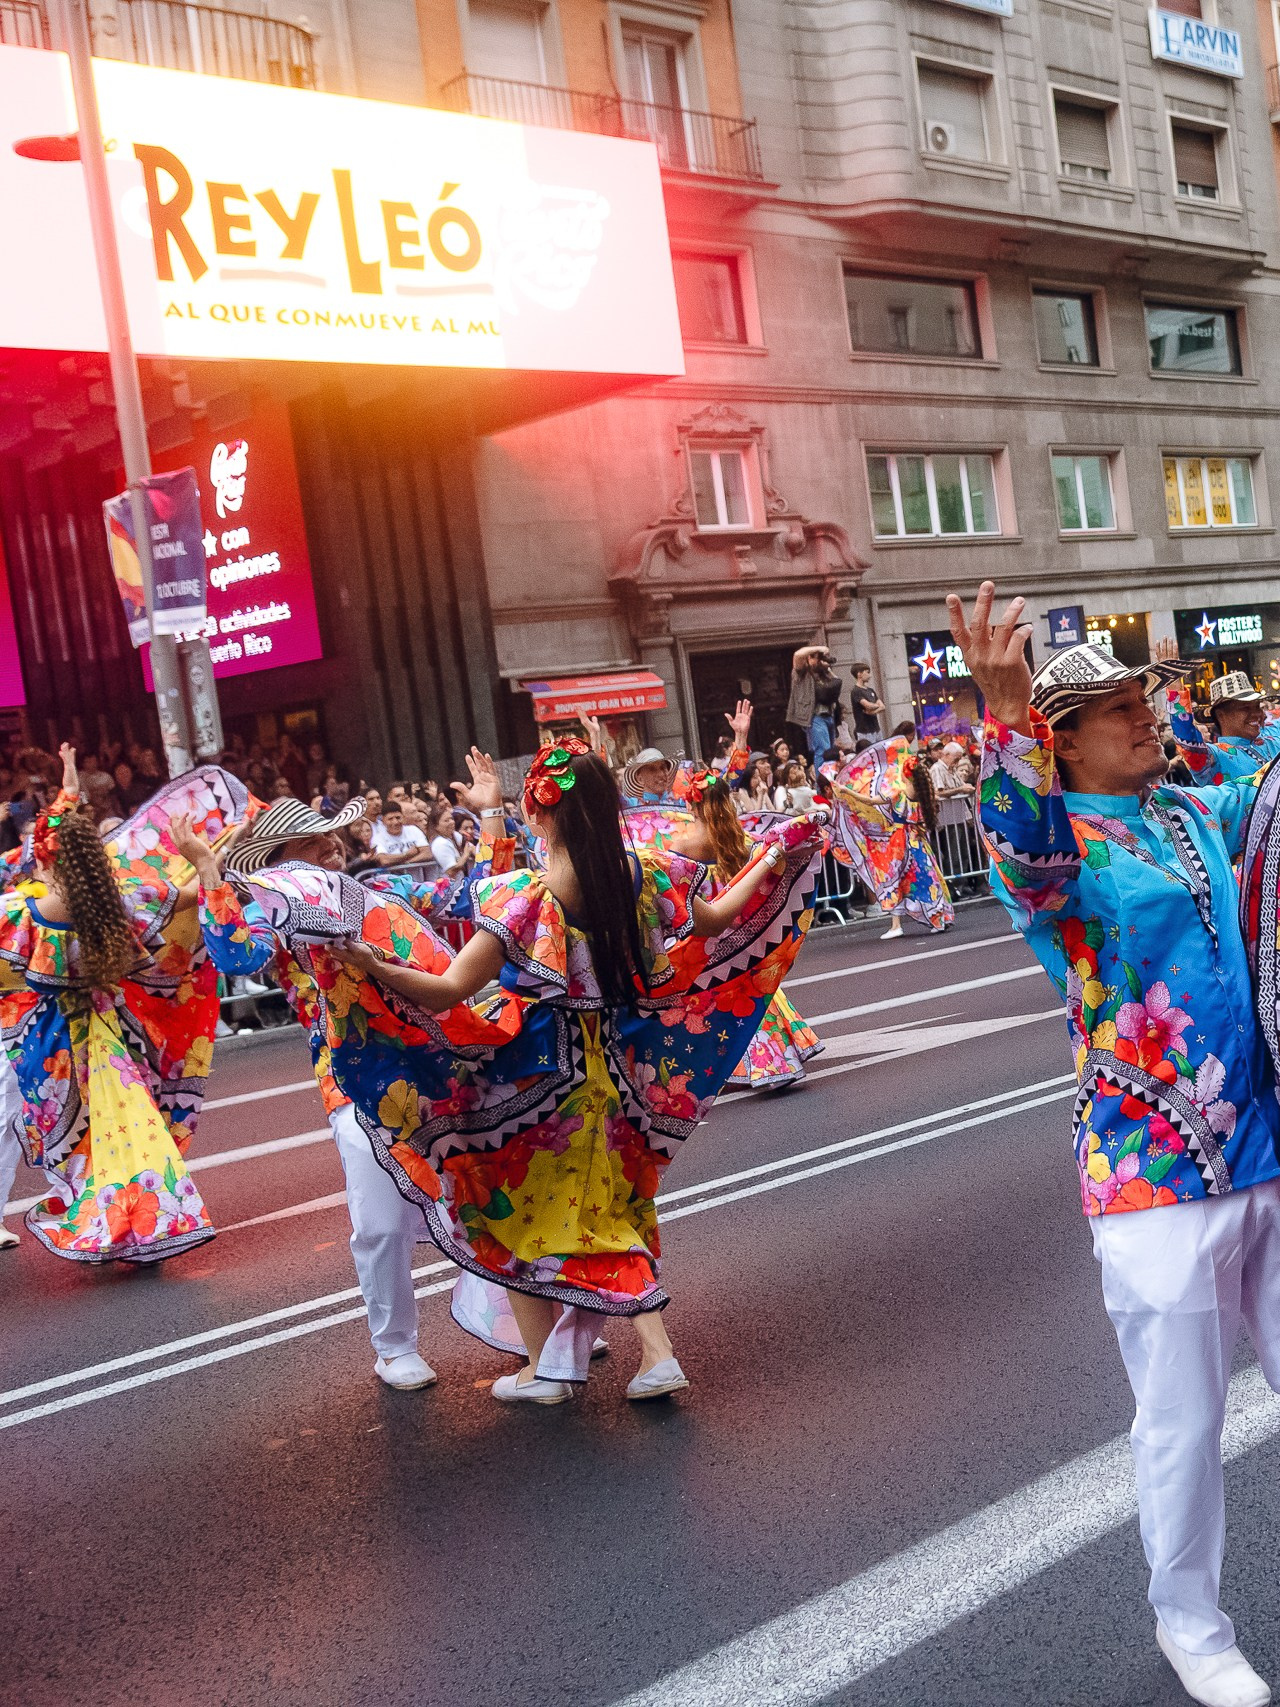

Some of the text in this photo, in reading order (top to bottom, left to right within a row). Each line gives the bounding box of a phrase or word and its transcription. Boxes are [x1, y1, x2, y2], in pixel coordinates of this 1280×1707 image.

[1162, 18, 1238, 57] LARVIN
[132, 142, 321, 283] REY
[209, 303, 267, 324] QUE
[277, 308, 423, 332] CONMUEVE
[431, 317, 459, 334] AL
[221, 527, 250, 551] con
[210, 551, 281, 592] opiniones
[1217, 615, 1262, 632] FOSTER'S
[1218, 628, 1263, 646] HOLLYWOOD
[209, 632, 273, 664] uerto Rico
[598, 697, 620, 710] GRAN
